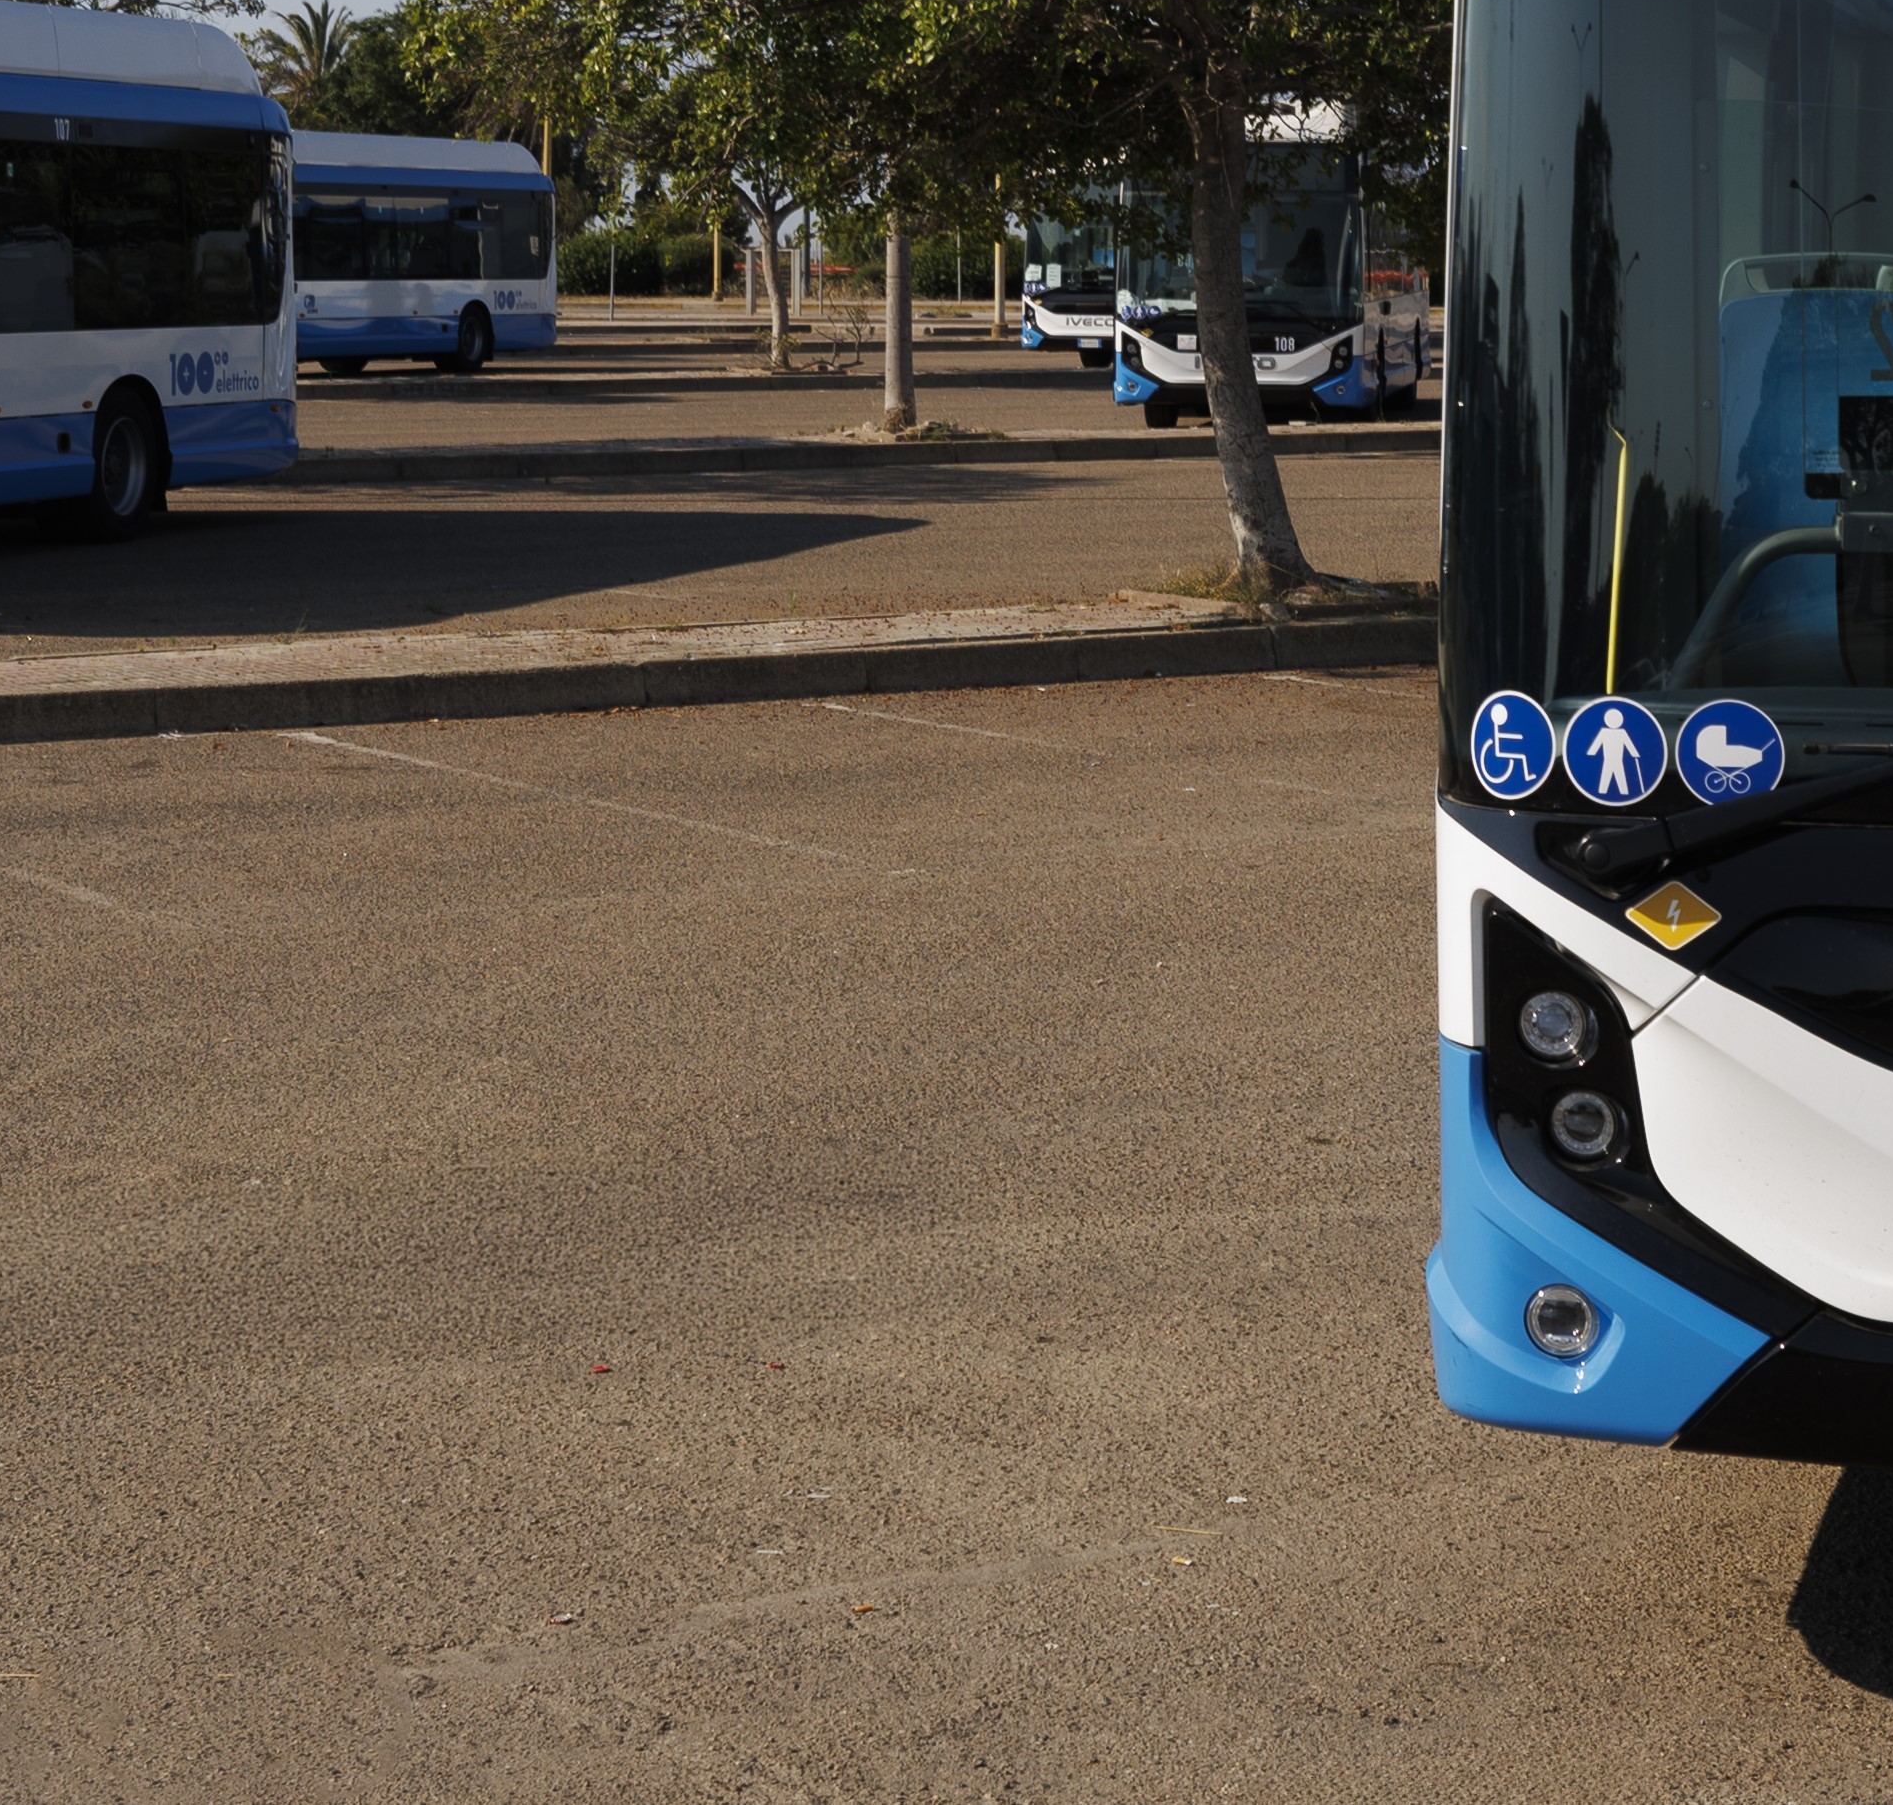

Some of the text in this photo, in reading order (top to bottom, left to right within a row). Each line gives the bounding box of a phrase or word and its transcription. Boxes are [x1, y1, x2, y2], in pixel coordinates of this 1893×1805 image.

[54, 117, 70, 141] 107
[1274, 336, 1295, 352] 108
[216, 369, 260, 393] elettrico
